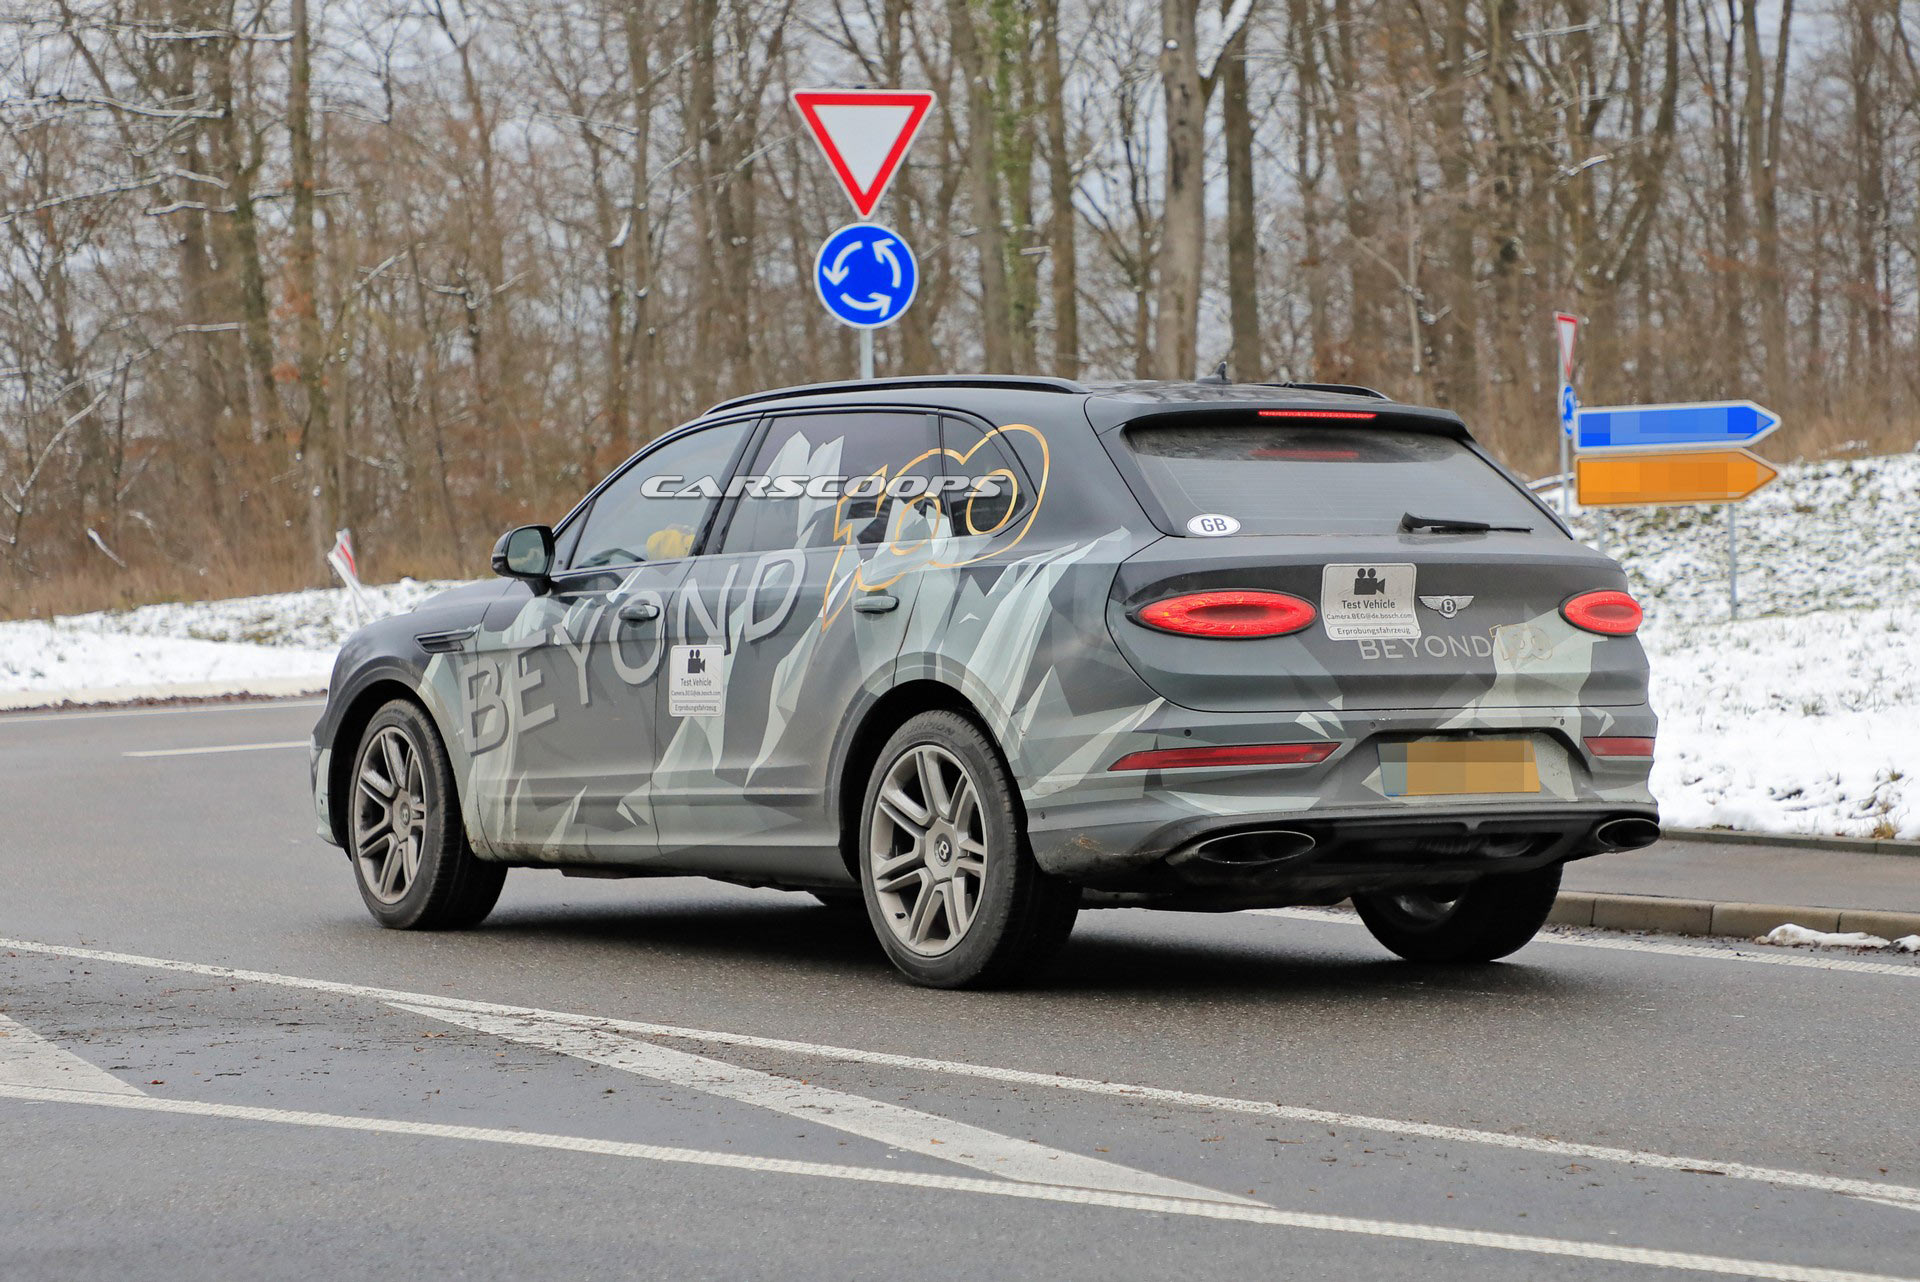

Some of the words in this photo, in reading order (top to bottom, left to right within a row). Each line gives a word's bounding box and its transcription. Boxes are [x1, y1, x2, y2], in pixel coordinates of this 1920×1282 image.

[1200, 518, 1228, 532] GB
[1341, 600, 1361, 609] Test
[1363, 599, 1396, 609] Vehicle
[1337, 626, 1411, 636] Erprobungsfahrzeug
[460, 548, 809, 756] BEYOND
[1357, 635, 1492, 660] BEYOND
[680, 678, 692, 687] Test
[693, 677, 712, 687] Vehicle
